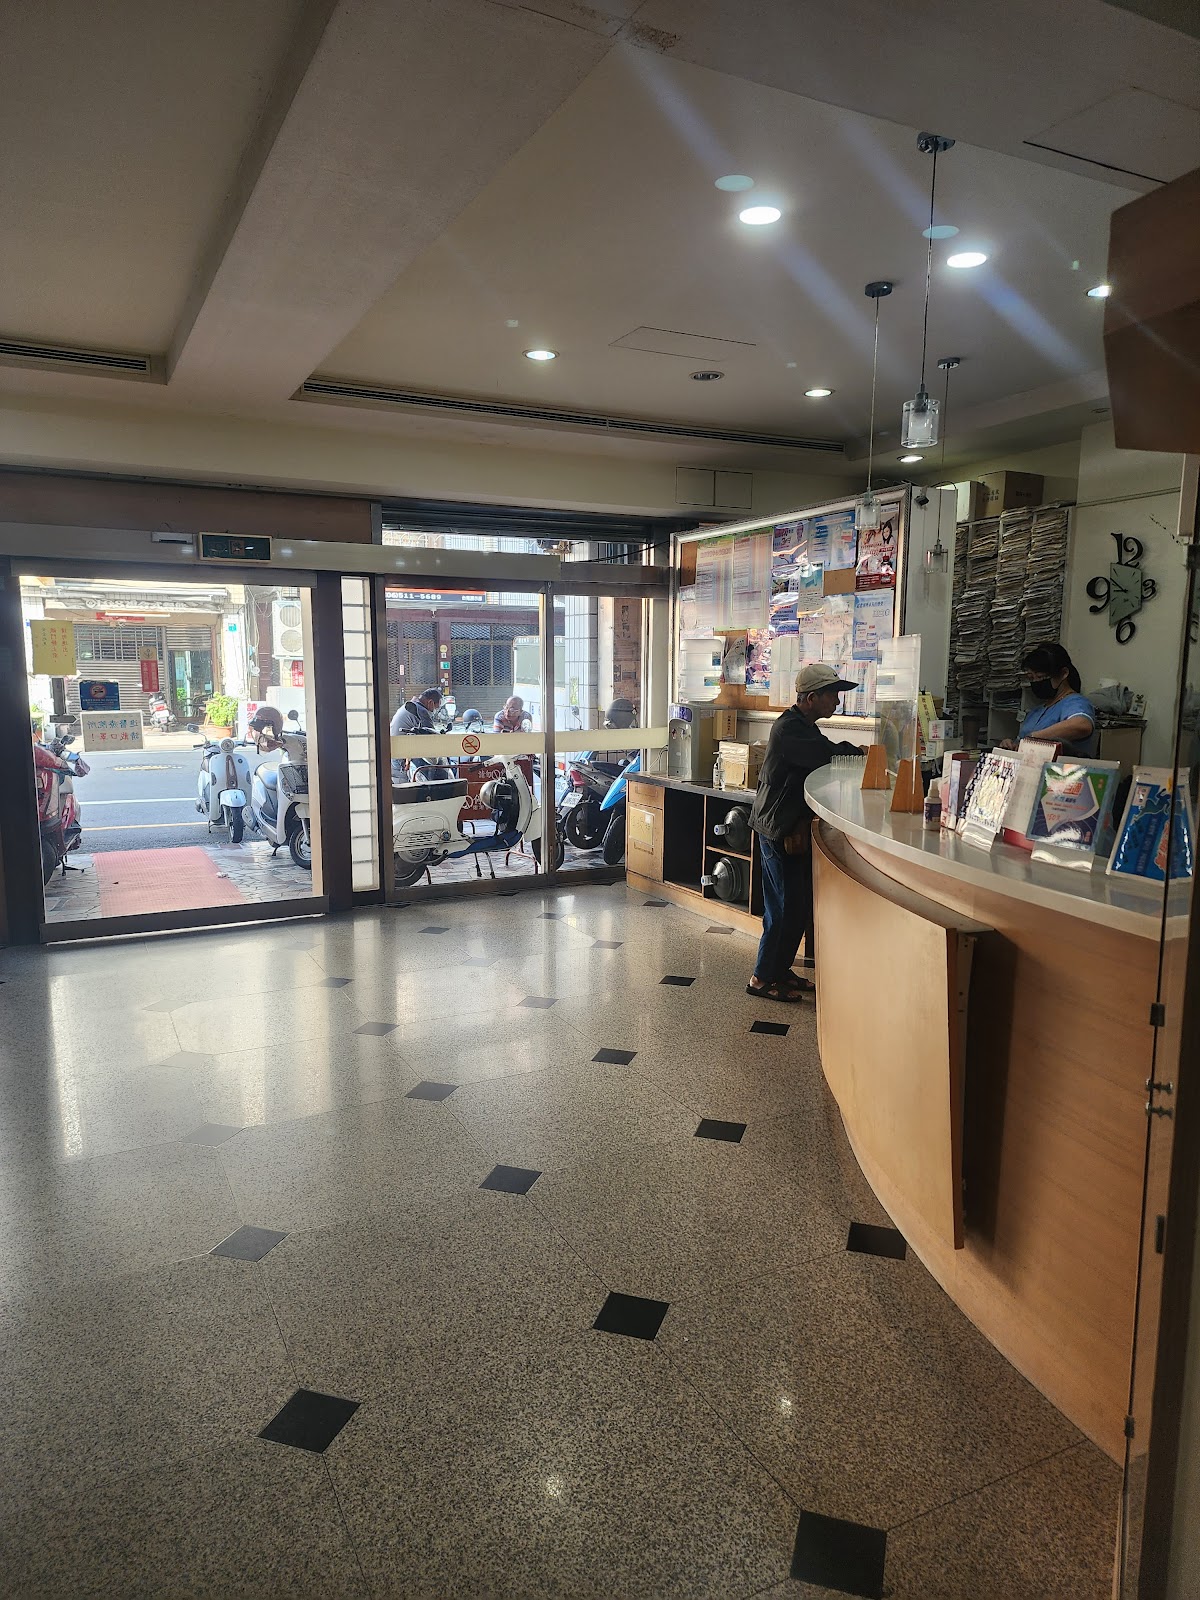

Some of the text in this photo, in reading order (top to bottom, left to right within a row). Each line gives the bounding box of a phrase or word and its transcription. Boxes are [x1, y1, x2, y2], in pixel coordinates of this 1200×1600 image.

[1110, 532, 1143, 568] 12
[1086, 576, 1111, 613] 9
[1142, 578, 1157, 599] 3
[1115, 616, 1136, 644] 6
